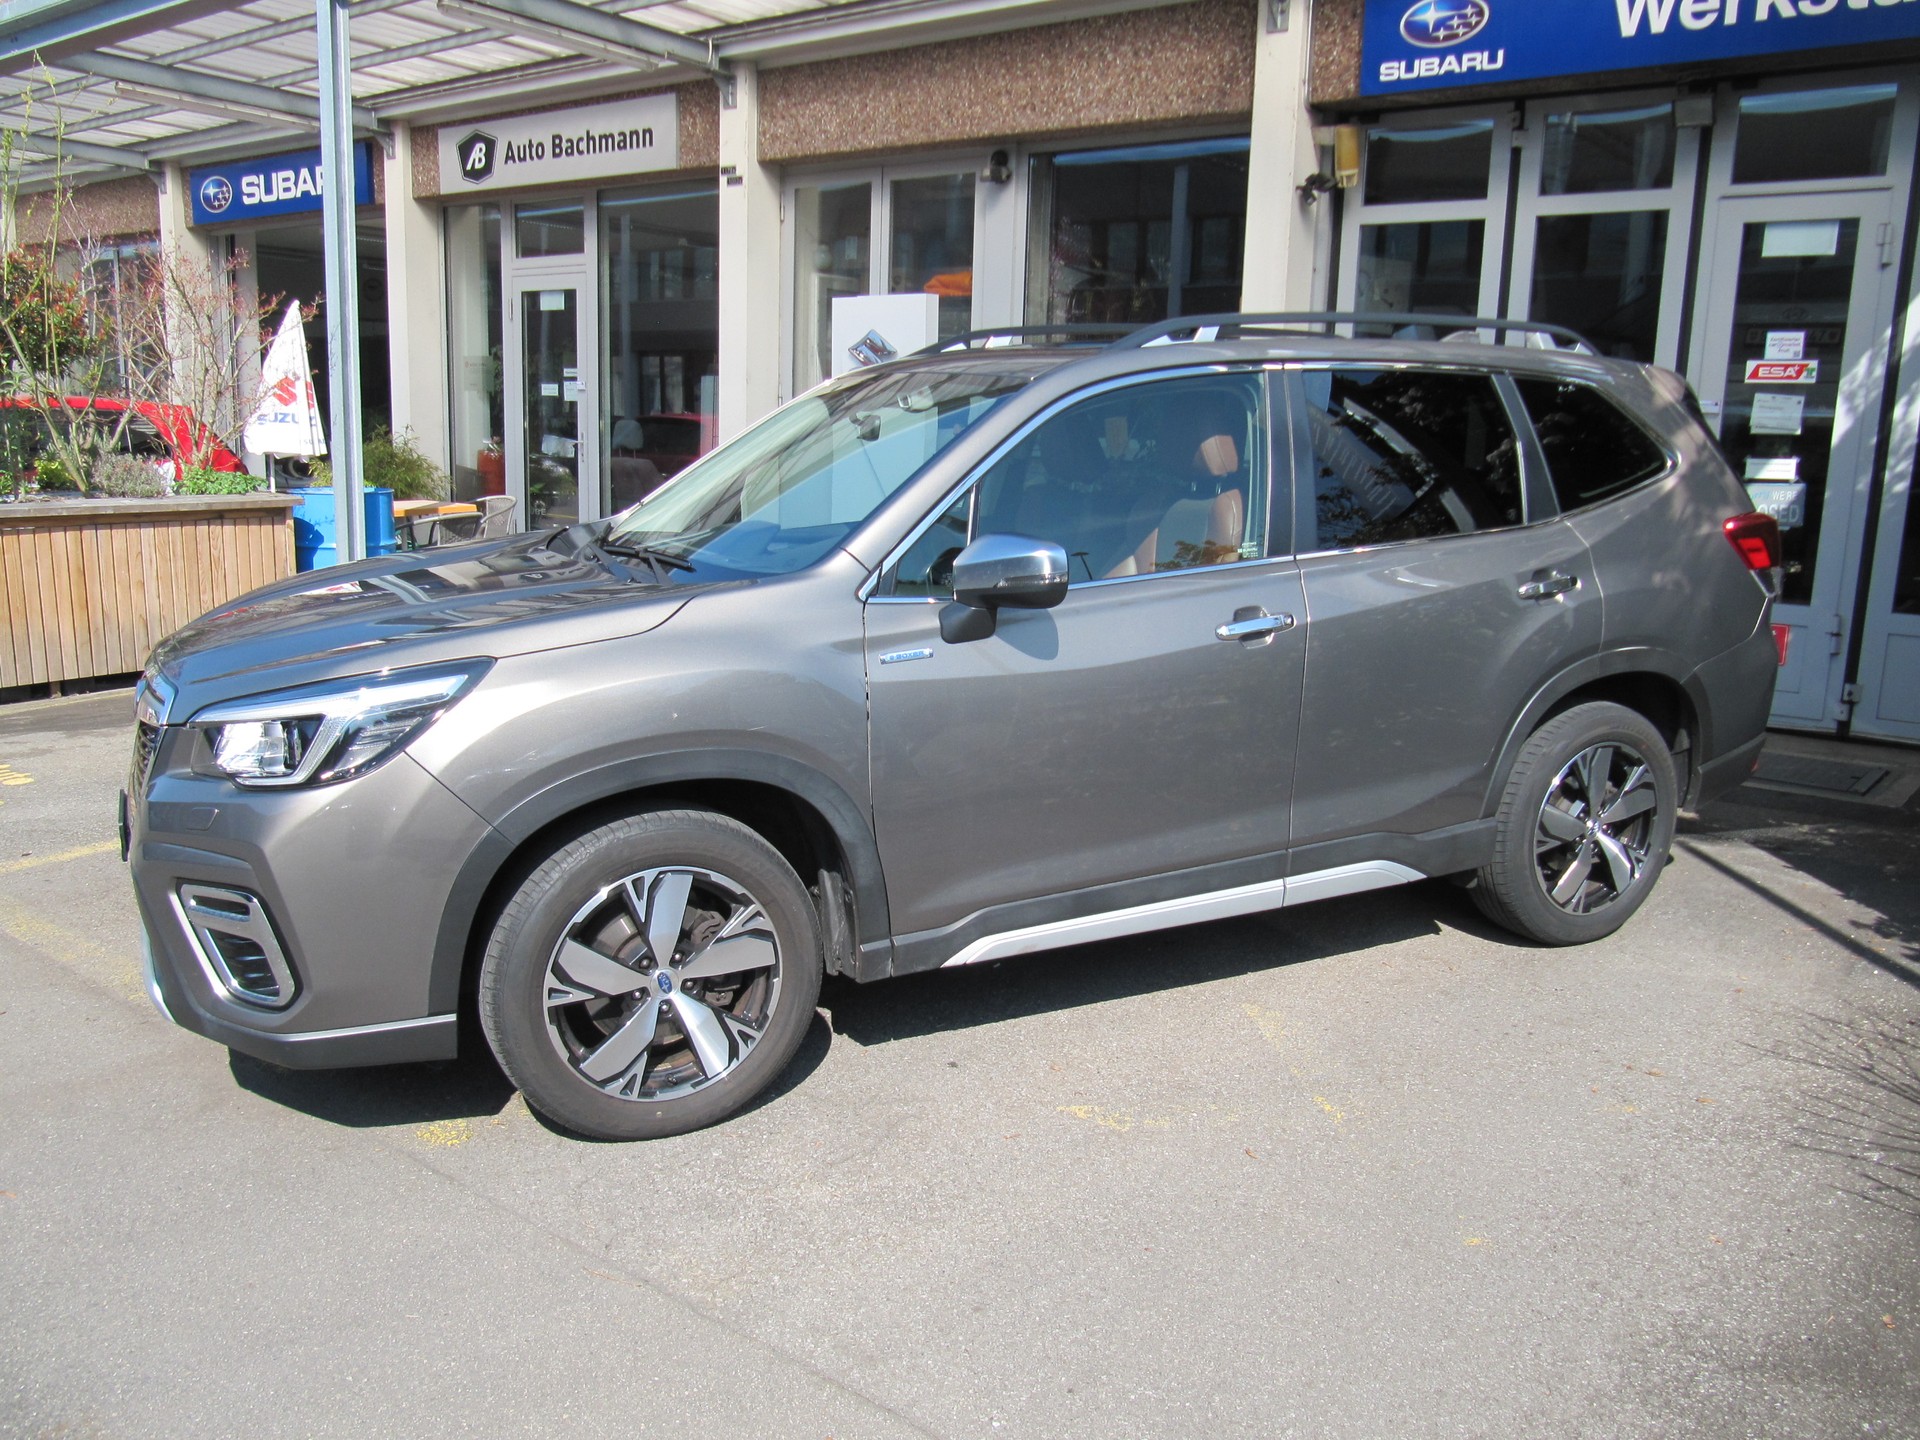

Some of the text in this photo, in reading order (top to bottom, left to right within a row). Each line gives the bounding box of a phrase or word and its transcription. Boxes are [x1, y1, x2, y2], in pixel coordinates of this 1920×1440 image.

[1615, 0, 1920, 38] Werks
[1378, 48, 1505, 83] SUBARU
[503, 126, 654, 165] Auto Bachmann
[241, 165, 324, 205] SUBA
